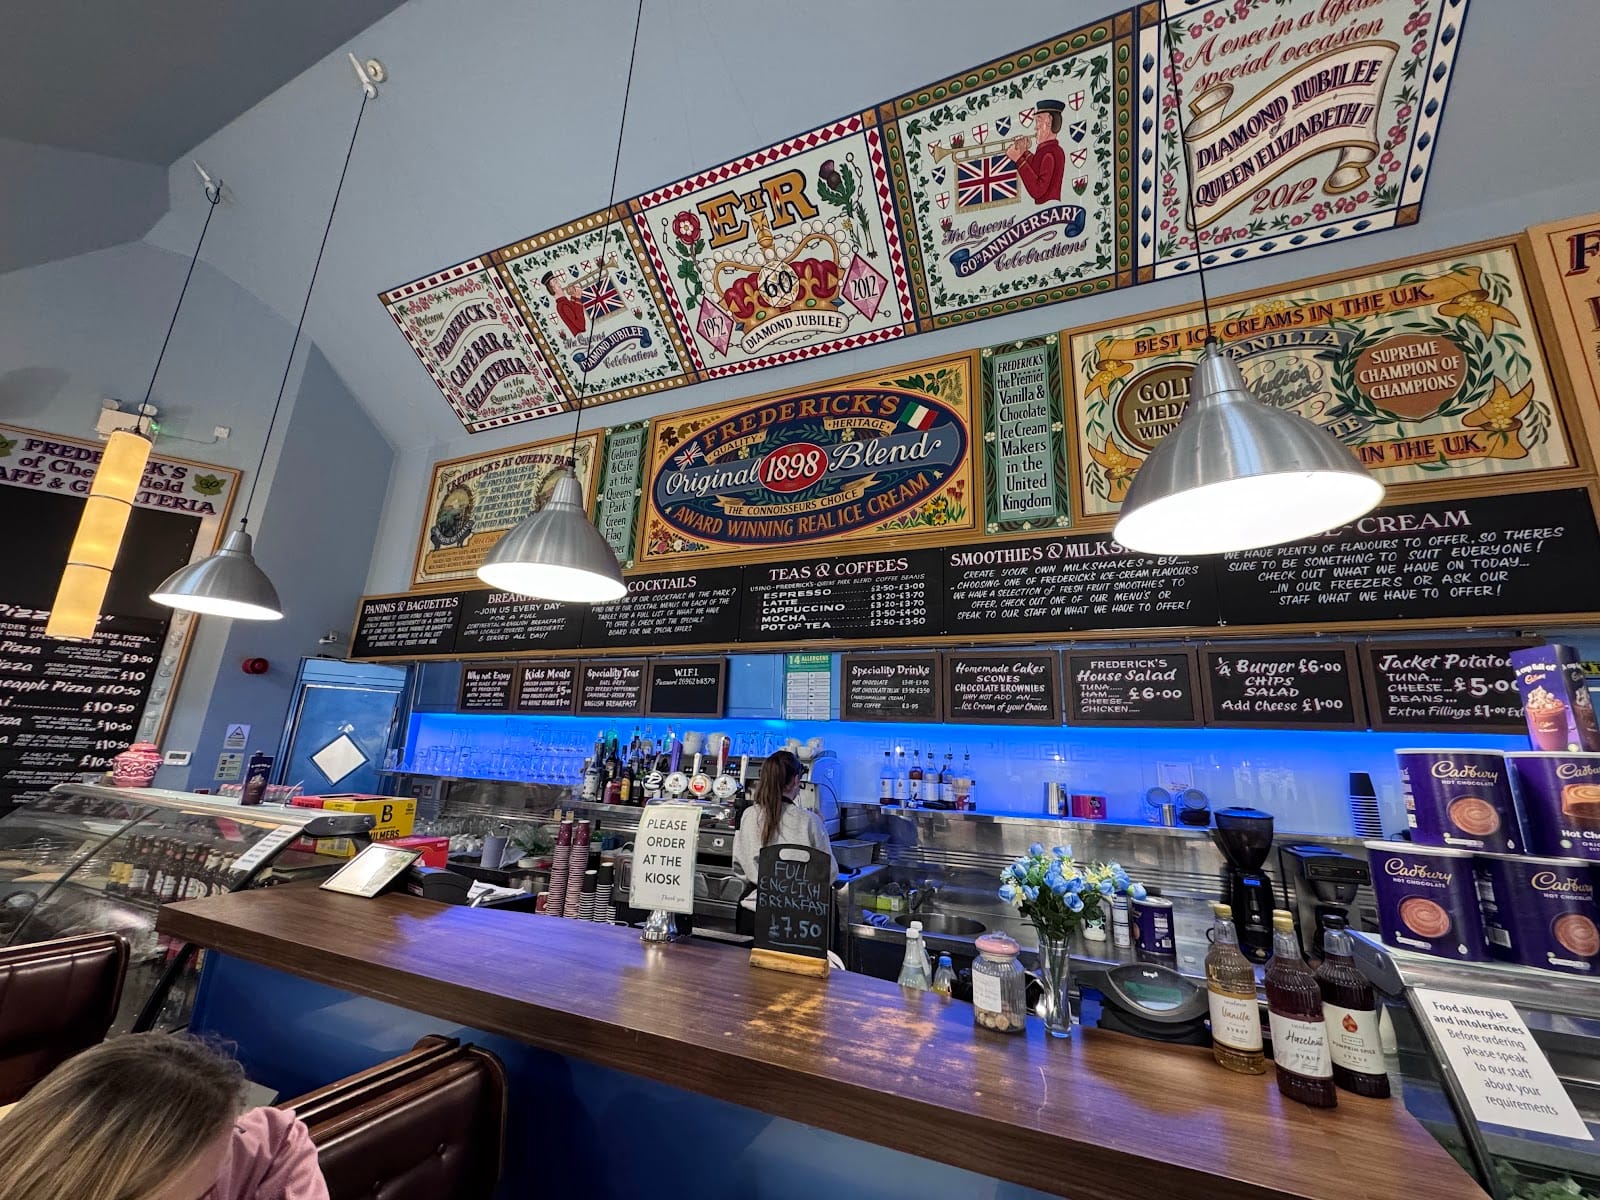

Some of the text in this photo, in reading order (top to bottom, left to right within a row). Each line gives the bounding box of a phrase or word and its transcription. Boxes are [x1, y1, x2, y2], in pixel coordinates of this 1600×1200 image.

[1182, 35, 1217, 71] A
[1219, 26, 1270, 53] once
[1272, 15, 1294, 40] in
[1297, 10, 1314, 31] a
[1192, 17, 1384, 92] special occasion
[1196, 60, 1382, 171] DIAMOND JUBILEE
[1194, 157, 1254, 208] QUEEN
[1257, 102, 1360, 170] ELIZABETH
[1250, 177, 1317, 214] 2012
[942, 215, 1016, 245] The Queens
[982, 207, 1081, 262] ANNIVERSARY
[995, 238, 1089, 271] Celebrations
[763, 271, 793, 298] 60
[851, 275, 877, 300] 2012
[1339, 292, 1385, 315] THE
[416, 311, 444, 328] Welcome
[702, 316, 727, 337] 1952
[1224, 303, 1334, 338] CREAMS IN
[564, 332, 606, 349] The Queens
[608, 326, 643, 349] JUBILEE
[746, 314, 843, 348] DIAMOND JUBILEE
[476, 332, 499, 366] BAR
[501, 332, 514, 350] &
[1134, 332, 1180, 355] BEST
[1370, 341, 1440, 365] SUPREME
[603, 349, 658, 369] Celebrations
[998, 355, 1044, 373] FREDERICK'S
[1359, 356, 1461, 384] CHAMPION OF
[465, 357, 531, 410] GELATERIA
[503, 377, 525, 389] in the
[998, 371, 1044, 390] the Premier
[1370, 375, 1457, 400] CHAMPIONS
[517, 385, 539, 398] Park
[1000, 385, 1045, 405] Vanilla &
[702, 395, 899, 447] FREDERICK'S
[1000, 404, 1046, 422] Chocolate
[832, 418, 886, 430] HERITAGE
[1000, 421, 1047, 440] Ice Cream
[713, 434, 758, 457] QUALITY
[1001, 440, 1047, 457] Makers
[1359, 445, 1384, 462] IN
[1390, 440, 1437, 460] THE
[666, 433, 942, 498] Original 1898 Blend
[1008, 456, 1043, 474] in the
[1006, 474, 1047, 492] United
[674, 473, 930, 538] AWARD WINNING REAL ICE CREAM
[728, 489, 858, 515] THE CONNOISSEURS CHOICE
[1003, 494, 1052, 512] Kingdom
[950, 543, 1063, 566] SMOOTHIES &
[769, 558, 908, 581] TEAS & COFFEES
[963, 558, 1143, 579] CREATE YOUR OWN MILKSHAKES
[628, 576, 697, 593] COCKTAILS
[365, 597, 459, 614] PANINIS & BAGUETTES
[852, 665, 930, 677] Speciality Drinks
[956, 662, 1045, 674] Homemade Cakes
[1090, 659, 1167, 669] FREDERICK'S
[1236, 660, 1295, 675] Burger
[1379, 655, 1441, 671] Jacket
[525, 669, 571, 680] Kids Meals
[587, 668, 639, 679] Speciality Teas
[1077, 669, 1177, 682] House Salad
[1245, 677, 1294, 686] CHIPS
[955, 684, 1045, 692] CHOCOLATE BROWNIES
[1244, 688, 1299, 697] SALAD
[1222, 700, 1250, 711] Add
[1255, 701, 1297, 711] Cheese
[1389, 706, 1470, 719] Extra Fillings
[1431, 760, 1498, 782] Cadbury
[647, 819, 687, 831] PLEASE
[647, 836, 685, 849] ORDER
[643, 854, 682, 867] AT THE
[645, 873, 680, 886] KIOSK
[775, 860, 809, 882] FULL
[1385, 858, 1452, 884] Cadbury
[759, 877, 820, 899] ENGLISH
[1532, 872, 1593, 893] Cadbury
[758, 894, 829, 916] BREAKFAST
[769, 914, 822, 939] £7.50
[1432, 1001, 1508, 1020] Food allergies
[1433, 1015, 1525, 1035] and intolerances
[1285, 1030, 1324, 1047] Hazelnut
[1449, 1029, 1526, 1051] Before ordering
[1463, 1045, 1528, 1064] please speak
[1475, 1062, 1531, 1079] to our staff
[1484, 1078, 1540, 1096] about your
[1486, 1095, 1558, 1116] requirements
